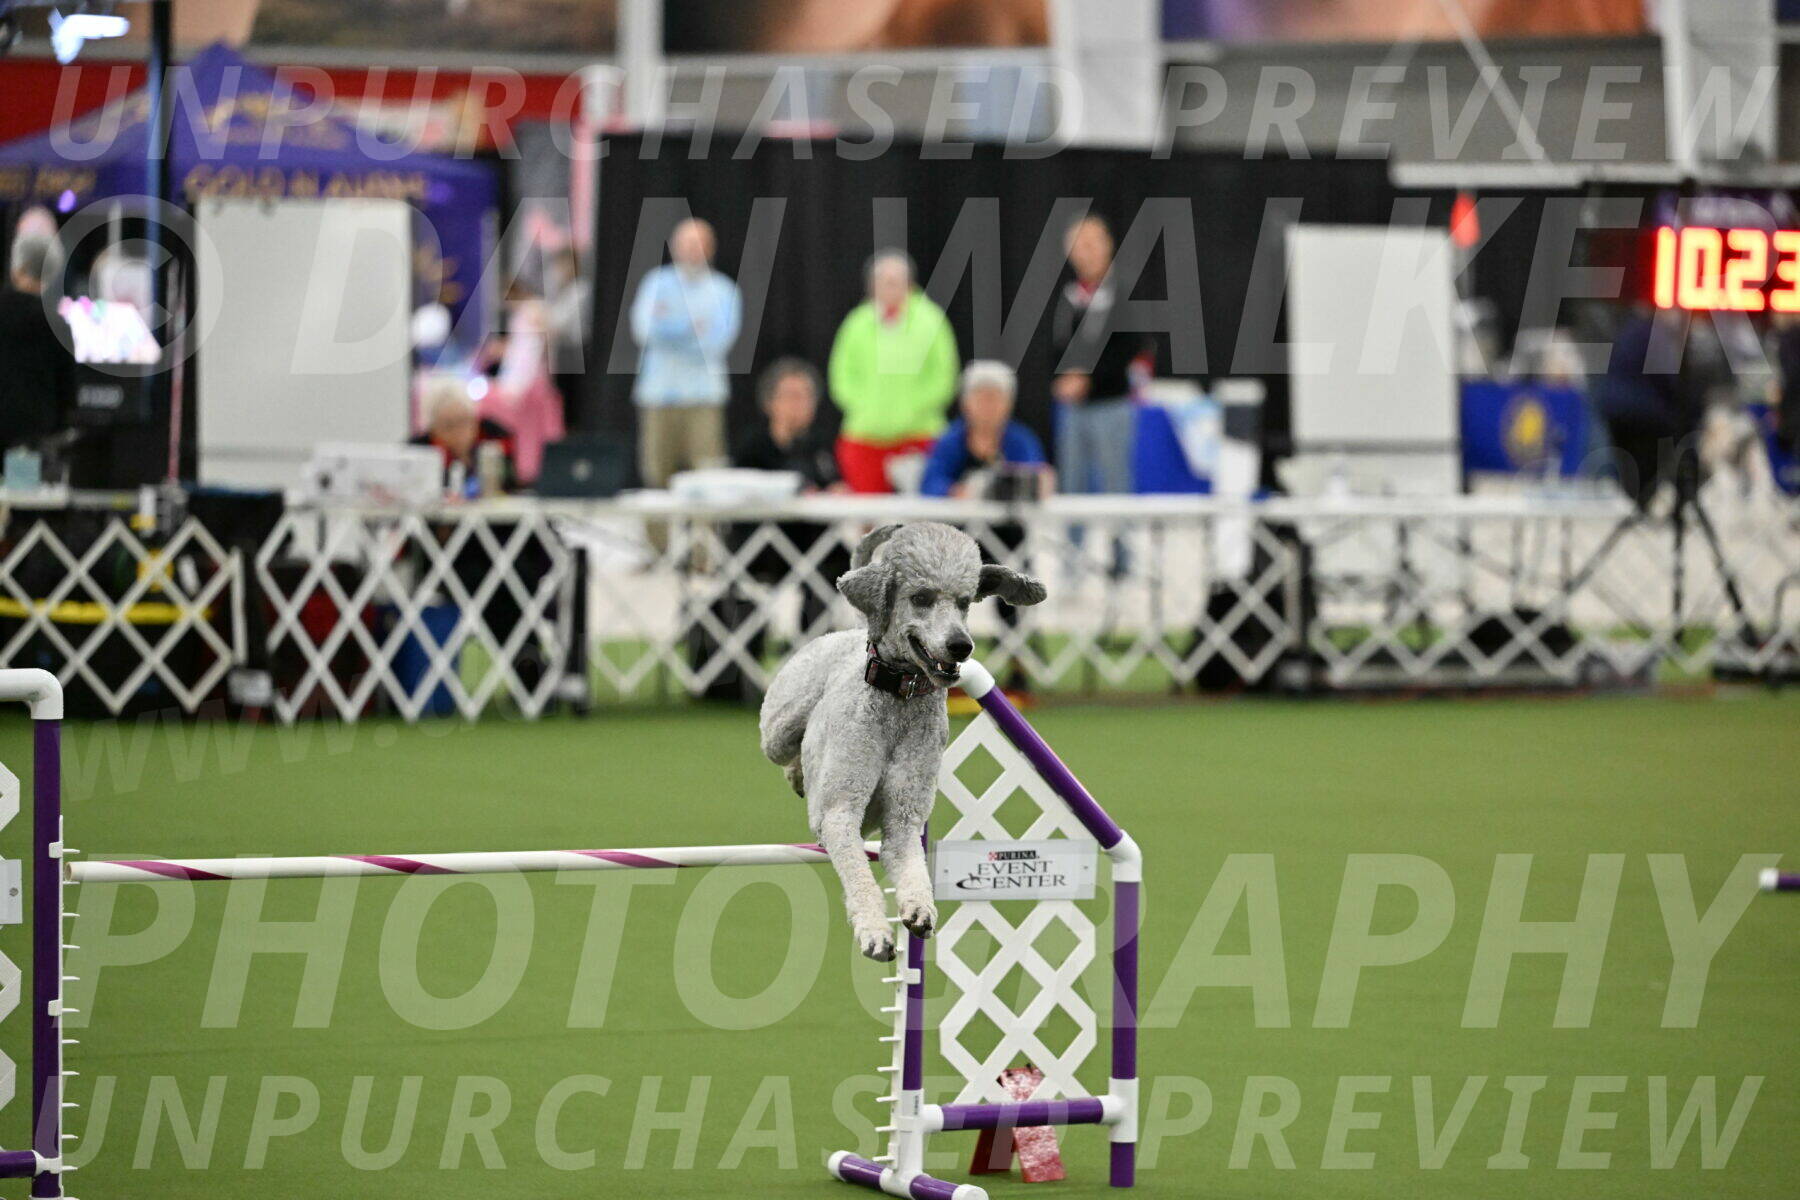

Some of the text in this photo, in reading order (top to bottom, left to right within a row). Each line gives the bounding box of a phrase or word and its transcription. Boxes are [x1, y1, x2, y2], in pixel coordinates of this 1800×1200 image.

[998, 850, 1037, 860] PURINA
[977, 860, 1054, 876] EVENT
[956, 872, 1067, 890] CENTER
